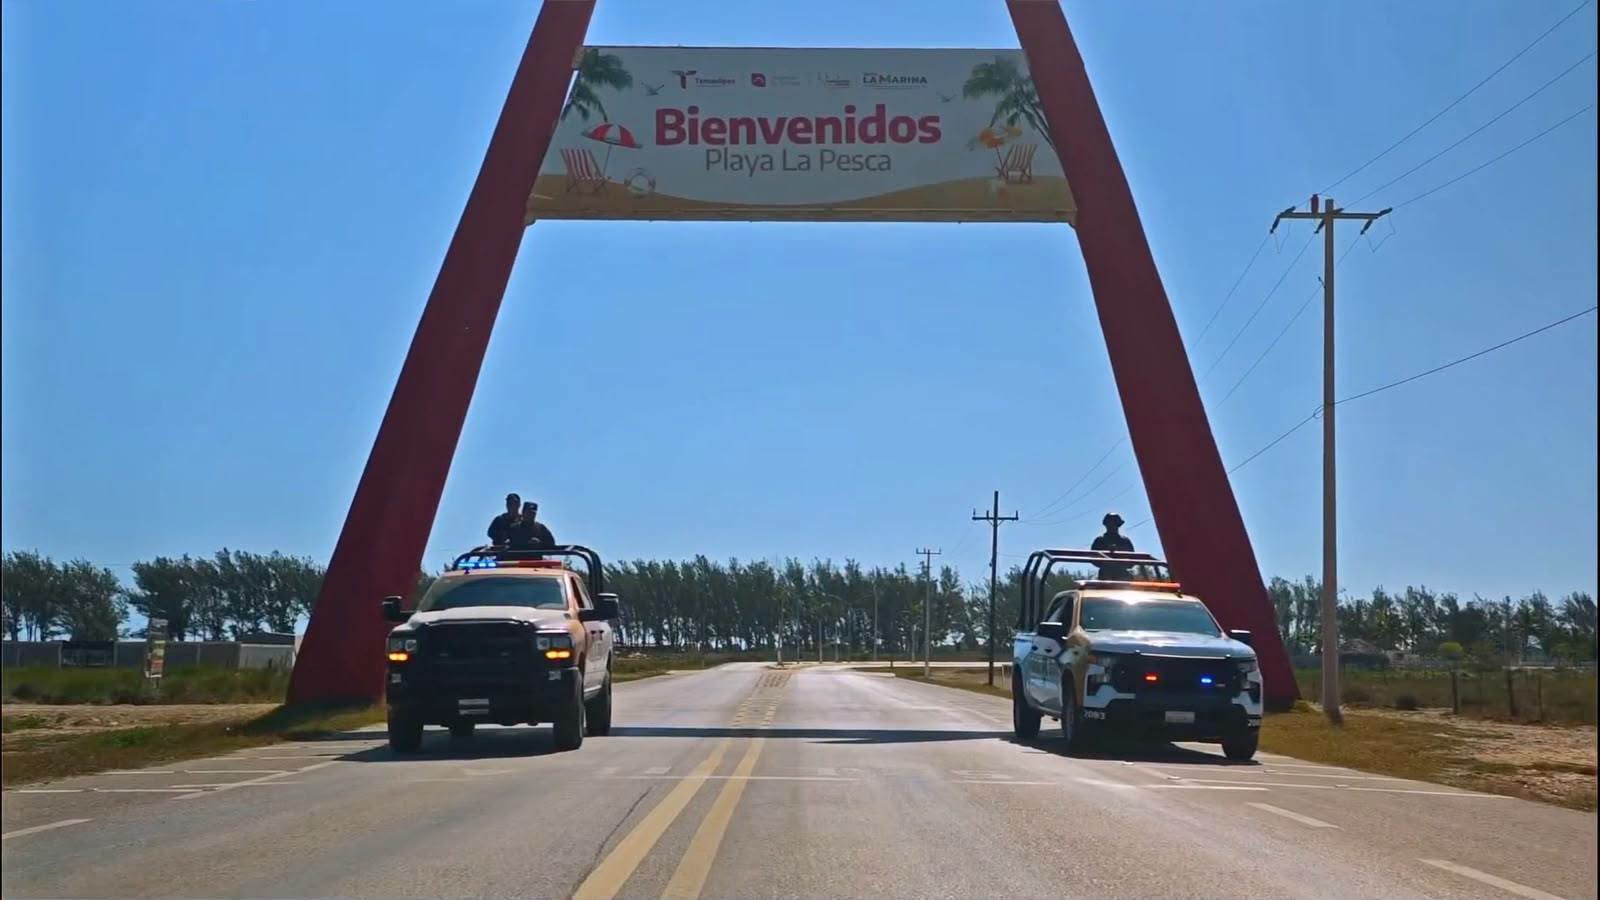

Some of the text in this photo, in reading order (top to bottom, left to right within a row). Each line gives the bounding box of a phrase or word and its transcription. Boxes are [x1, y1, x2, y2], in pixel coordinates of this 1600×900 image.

[863, 74, 928, 84] LA MARINA
[656, 105, 941, 145] Bienvenidos
[706, 148, 891, 177] Playa La Pesca
